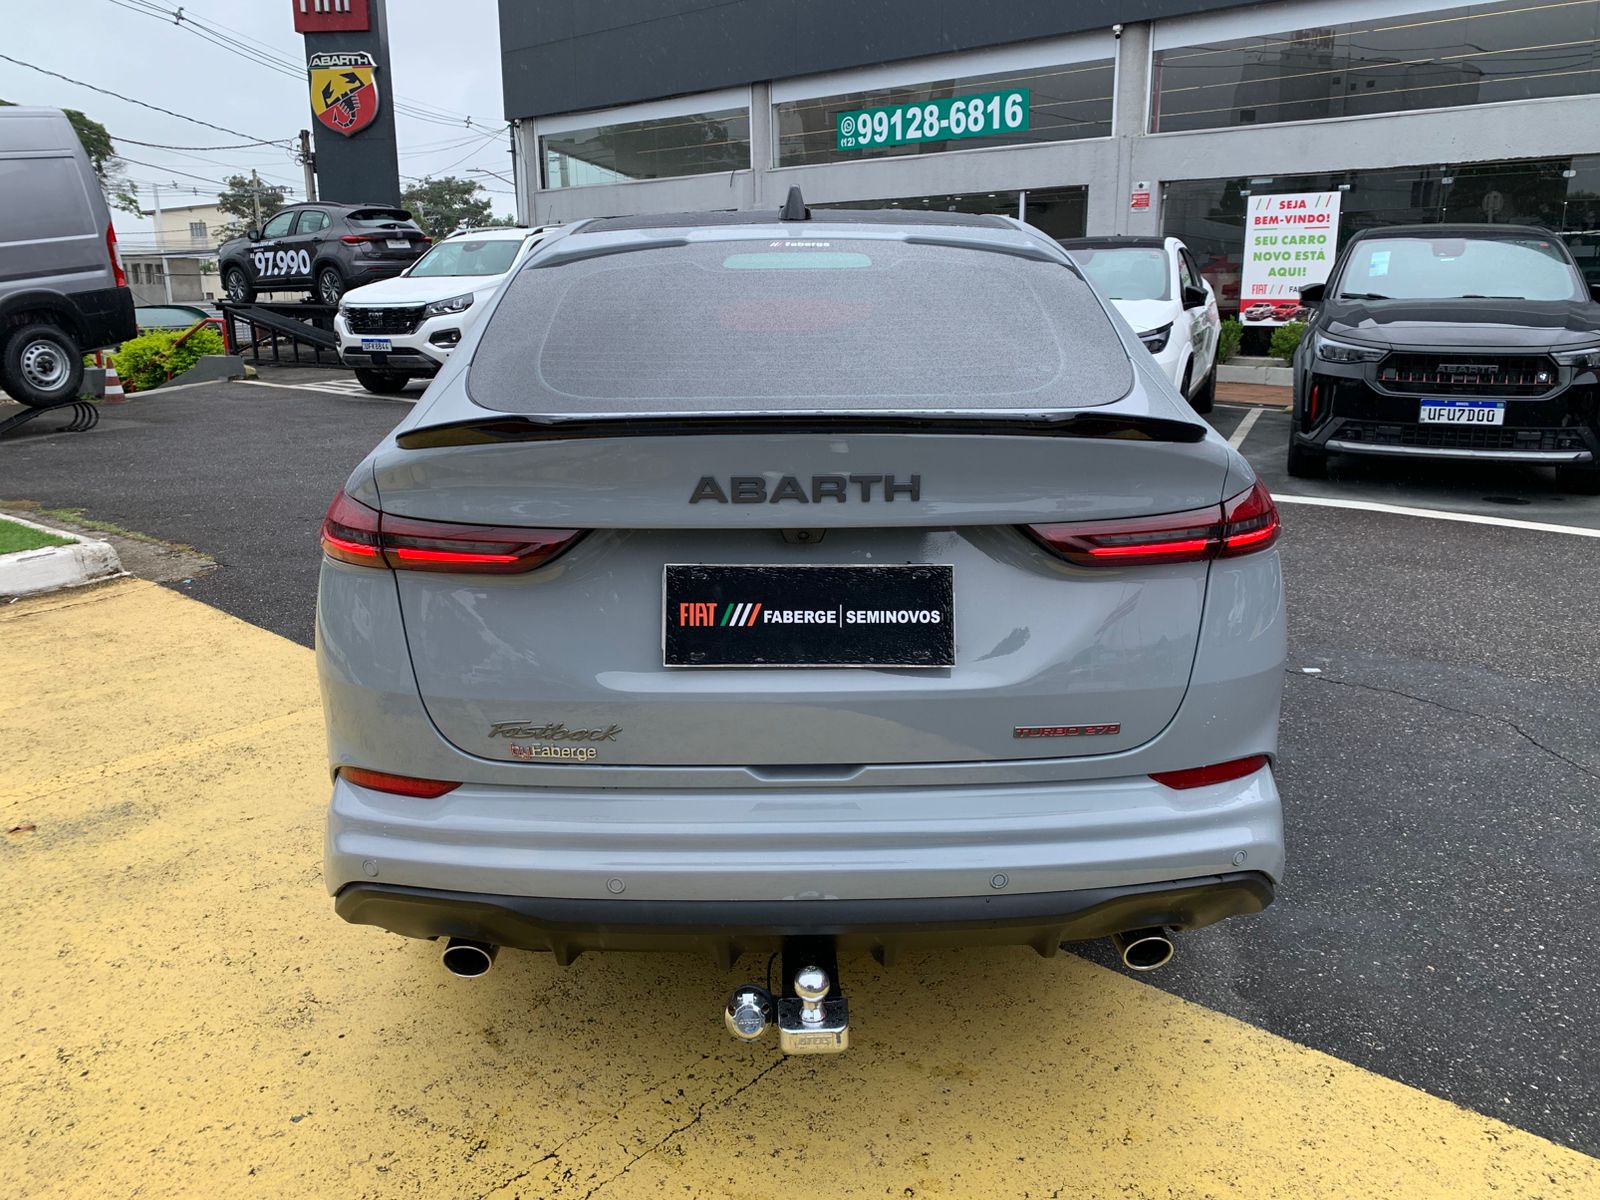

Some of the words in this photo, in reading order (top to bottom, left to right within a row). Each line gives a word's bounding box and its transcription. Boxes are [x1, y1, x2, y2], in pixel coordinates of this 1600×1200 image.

[311, 55, 369, 67] ABARTH
[857, 93, 1023, 145] 99128-6816
[840, 137, 855, 147] (12)
[1279, 200, 1307, 210] SEJA
[1254, 214, 1331, 225] BEM-VINDO!
[1254, 236, 1278, 246] SEU
[1281, 235, 1327, 245] CARRO
[1253, 251, 1291, 261] NOVO
[1295, 247, 1326, 260] ESTÁ
[254, 249, 311, 276] 97.990
[1268, 267, 1307, 277] AQUI!
[1251, 284, 1268, 295] FIAT
[688, 474, 921, 504] ABARTH
[679, 603, 717, 626] FIAT
[763, 610, 837, 624] FABERGE
[846, 610, 941, 624] SEMINOVOS
[487, 720, 623, 742] Fastback
[1016, 727, 1080, 738] TURBO
[1084, 725, 1120, 735] 270
